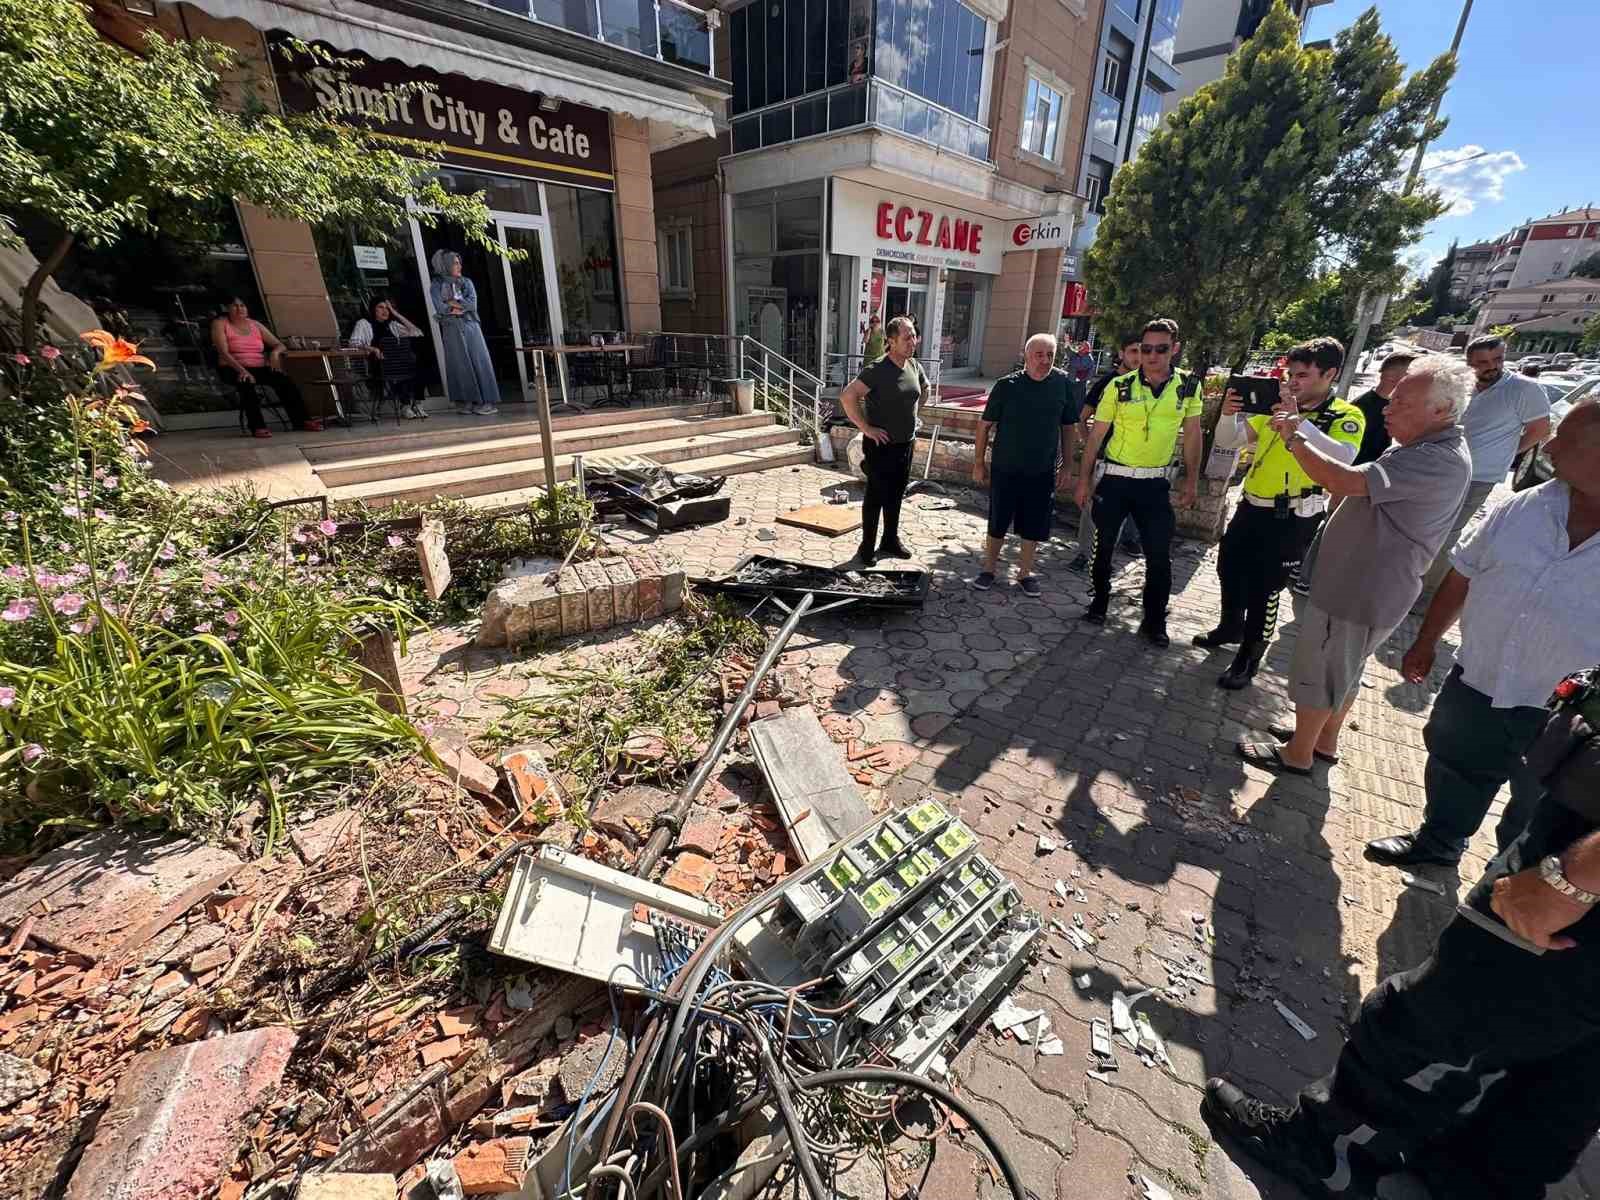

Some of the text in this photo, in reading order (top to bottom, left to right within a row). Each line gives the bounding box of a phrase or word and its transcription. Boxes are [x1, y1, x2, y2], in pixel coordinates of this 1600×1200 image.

[311, 66, 590, 158] Simit City & Cafe
[876, 202, 983, 254] ECZANE
